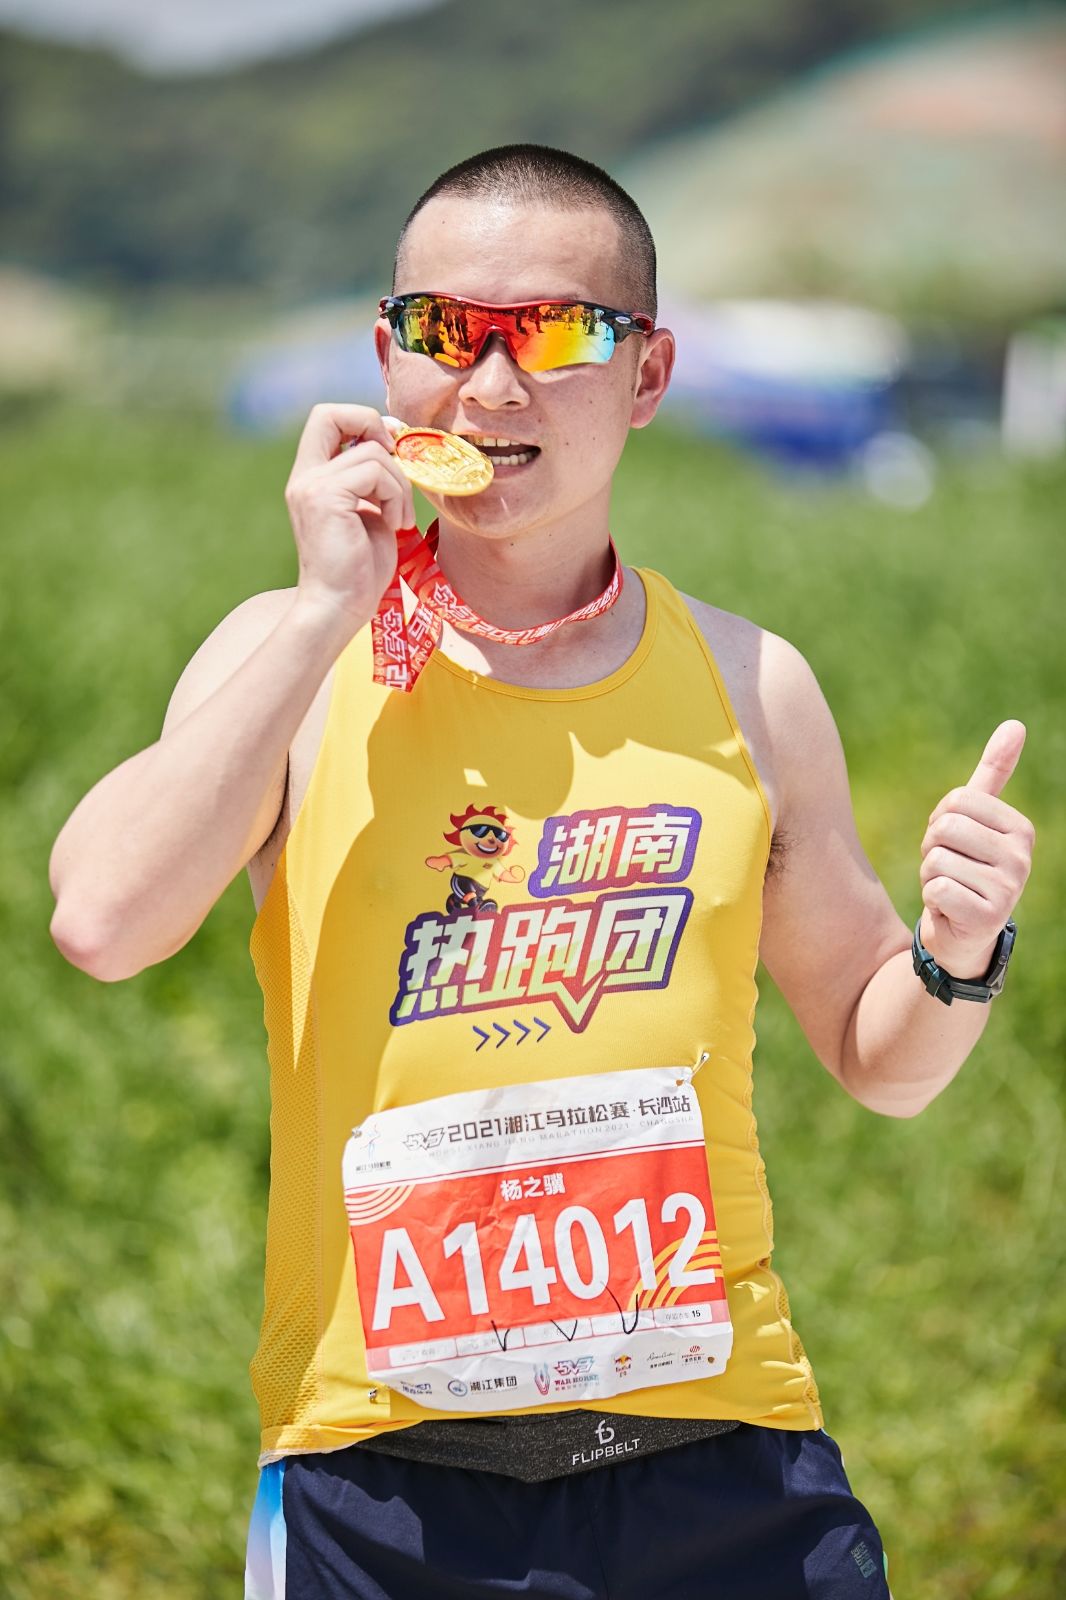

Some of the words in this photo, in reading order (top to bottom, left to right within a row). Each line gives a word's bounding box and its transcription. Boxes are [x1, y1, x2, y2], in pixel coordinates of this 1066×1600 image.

[538, 809, 695, 891] 湖南
[393, 891, 690, 1030] 热跑团
[371, 1192, 717, 1331] A14012
[691, 1309, 701, 1319] 15
[571, 1438, 641, 1466] FLIPBELT
